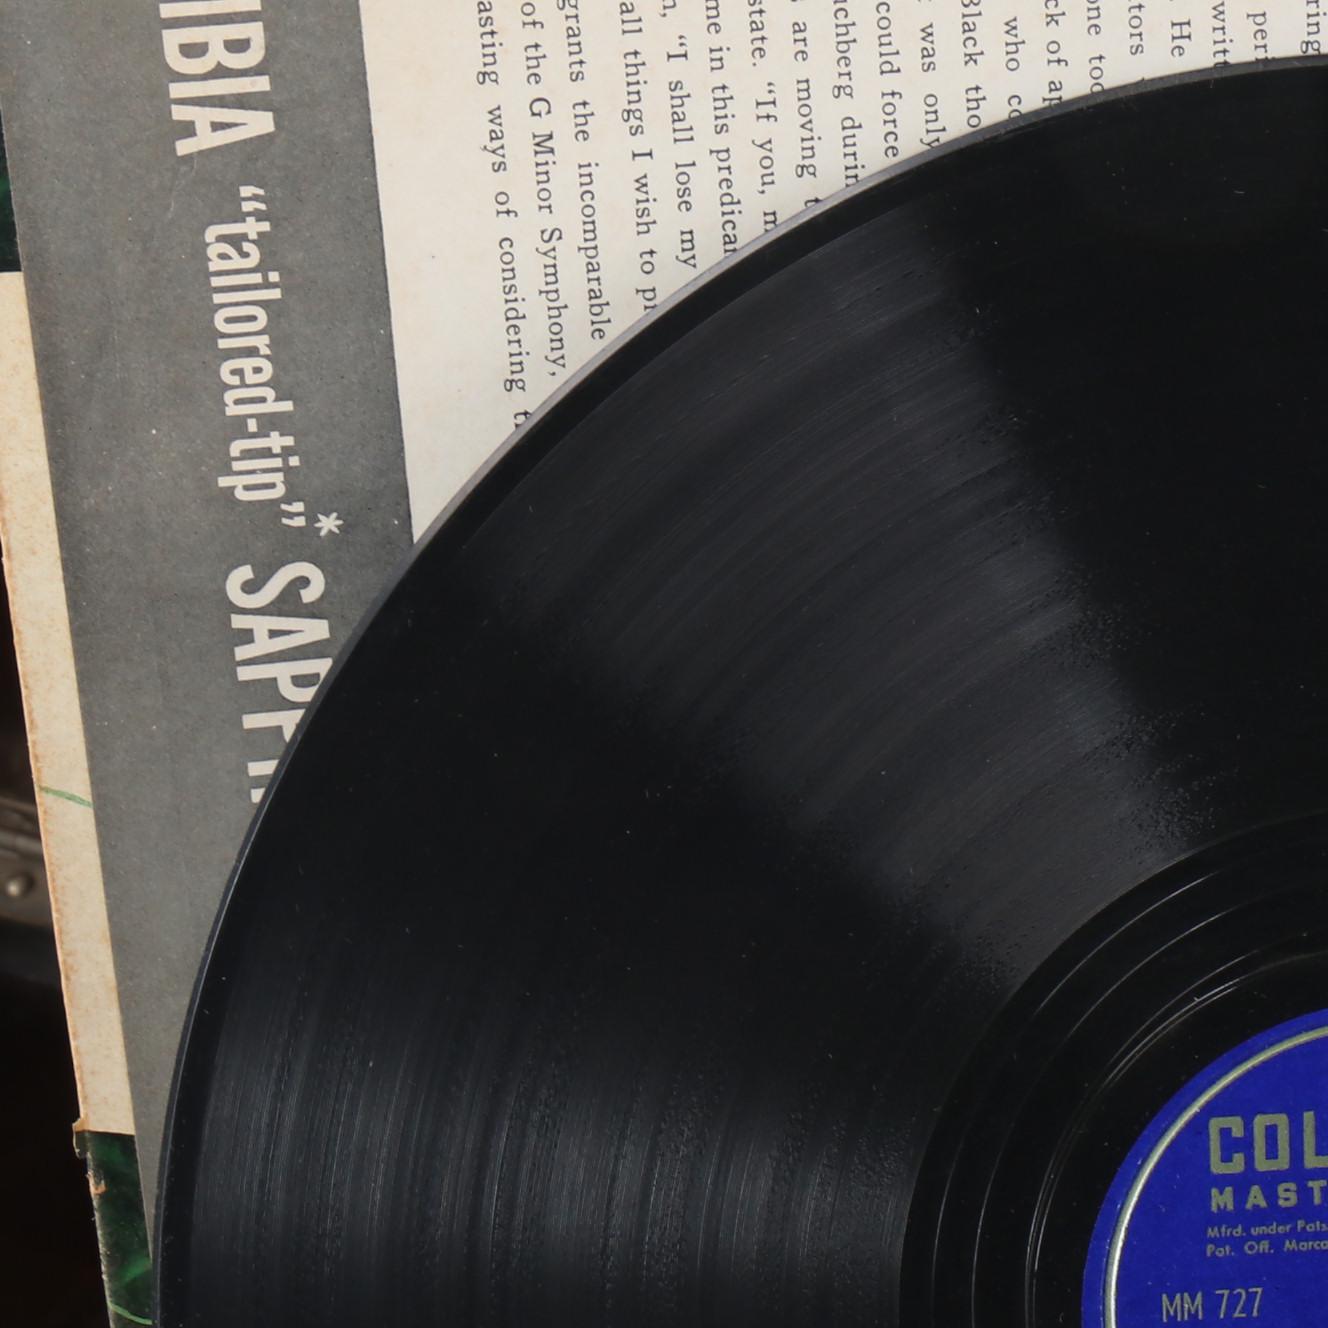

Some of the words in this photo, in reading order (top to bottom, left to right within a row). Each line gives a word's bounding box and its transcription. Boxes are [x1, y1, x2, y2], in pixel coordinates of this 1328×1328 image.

[520, 2, 544, 29] of
[619, 1, 643, 36] all
[876, 1, 902, 76] could
[1128, 0, 1146, 56] tors
[1170, 19, 1192, 57] He
[524, 42, 547, 85] the
[709, 46, 731, 72] in
[792, 21, 809, 62] are
[920, 22, 937, 73] was
[1004, 16, 1026, 72] who
[1046, 40, 1068, 66] of
[529, 97, 551, 118] G
[621, 49, 648, 136] things
[668, 80, 695, 144] shall
[711, 83, 736, 135] this
[480, 105, 508, 173] ways
[572, 100, 595, 142] the
[795, 77, 822, 178] moving
[881, 89, 902, 158] force
[920, 93, 947, 149] only
[532, 131, 557, 214] Minor
[675, 161, 696, 212] lose
[752, 138, 777, 195] you,
[495, 192, 518, 218] of
[633, 173, 657, 236] wish
[577, 162, 612, 340] incomparable
[639, 248, 658, 275] to
[676, 229, 697, 269] my
[499, 236, 530, 393] considering
[536, 227, 569, 377] Symphony,
[1206, 1220, 1247, 1239] Mfrd.
[1250, 1218, 1293, 1235] under
[1206, 1241, 1236, 1258] Pat.
[1244, 1239, 1275, 1256] Off.
[1161, 1291, 1203, 1323] MM
[1215, 1287, 1264, 1320] 727
